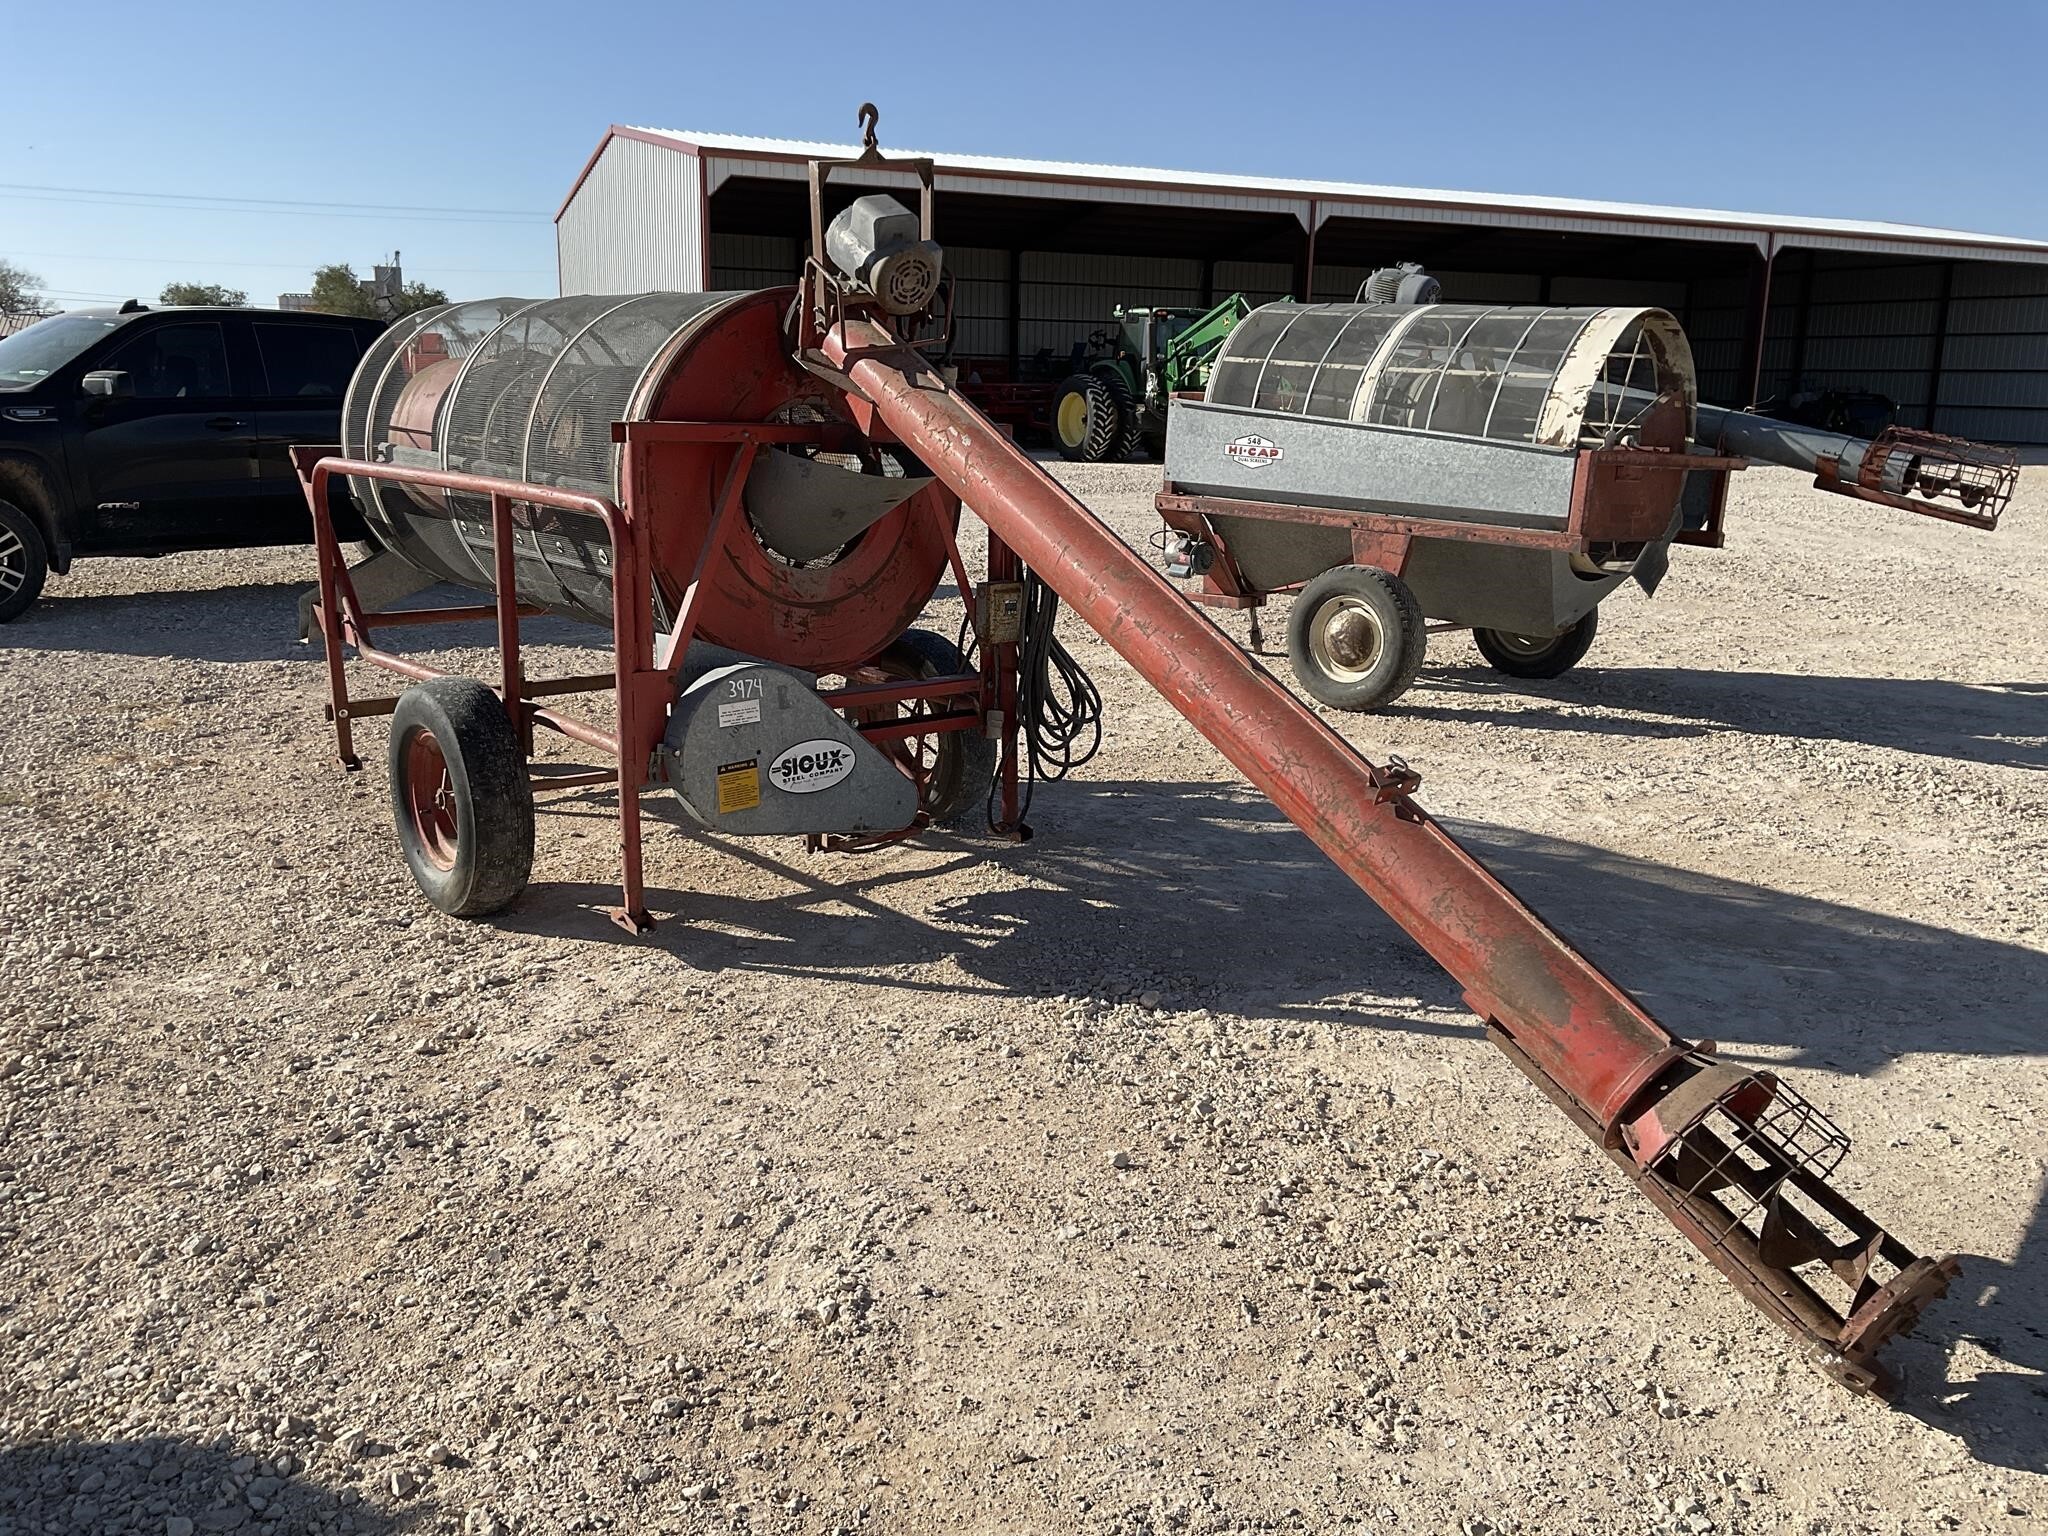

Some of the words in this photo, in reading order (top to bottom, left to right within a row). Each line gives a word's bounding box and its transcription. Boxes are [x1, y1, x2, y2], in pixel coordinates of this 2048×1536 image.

[1247, 437, 1261, 445] 548
[728, 678, 764, 698] 3974
[781, 749, 843, 777] SIOUX
[808, 767, 844, 778] COMPANY
